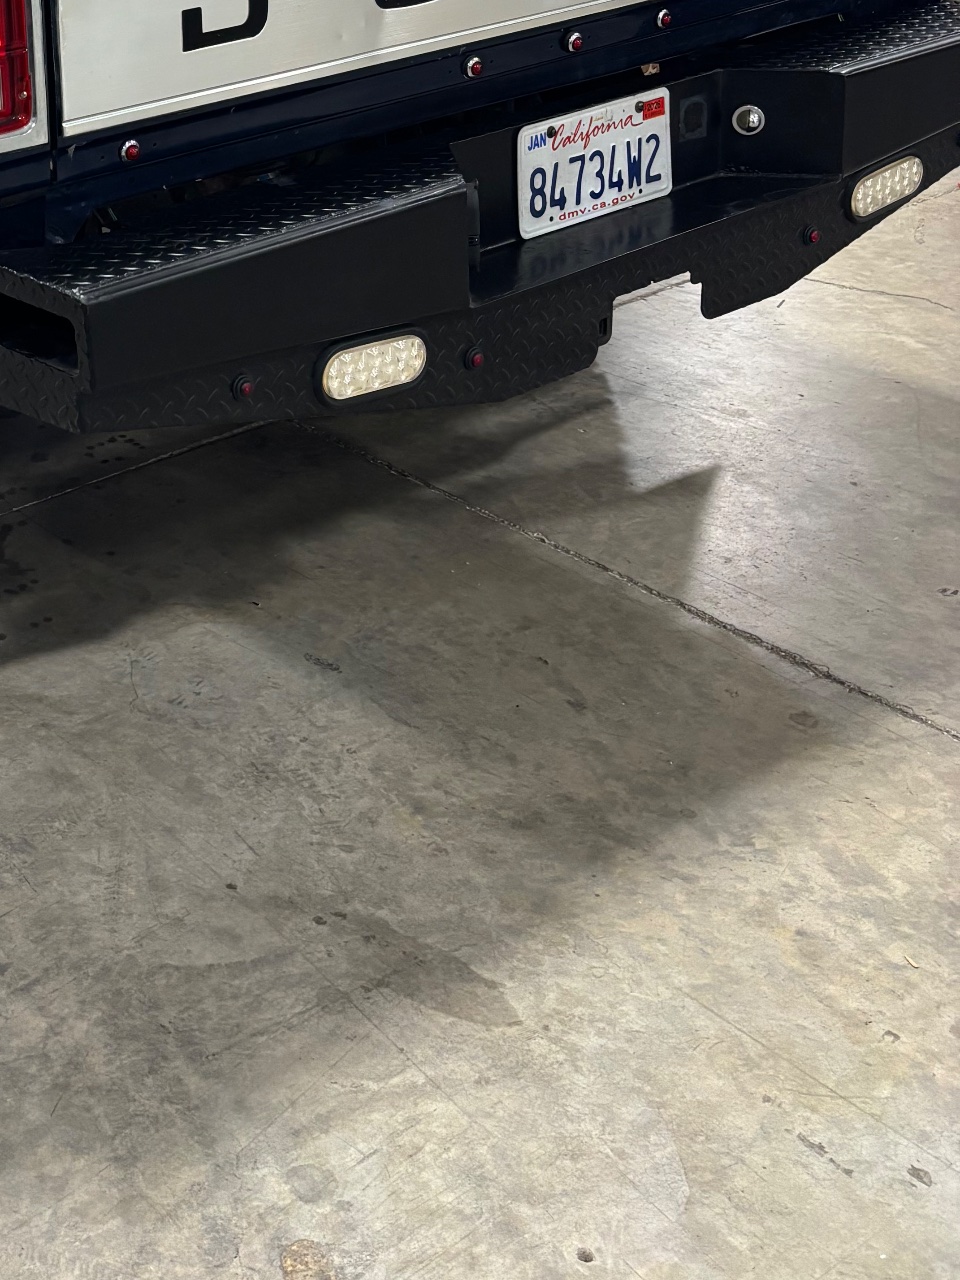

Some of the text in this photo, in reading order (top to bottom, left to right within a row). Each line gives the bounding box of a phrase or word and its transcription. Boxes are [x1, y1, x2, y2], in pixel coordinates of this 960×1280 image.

[527, 132, 547, 152] JAN
[551, 113, 644, 151] California
[529, 133, 662, 218] 84734W2
[558, 192, 636, 221] dmv.ca.gov
